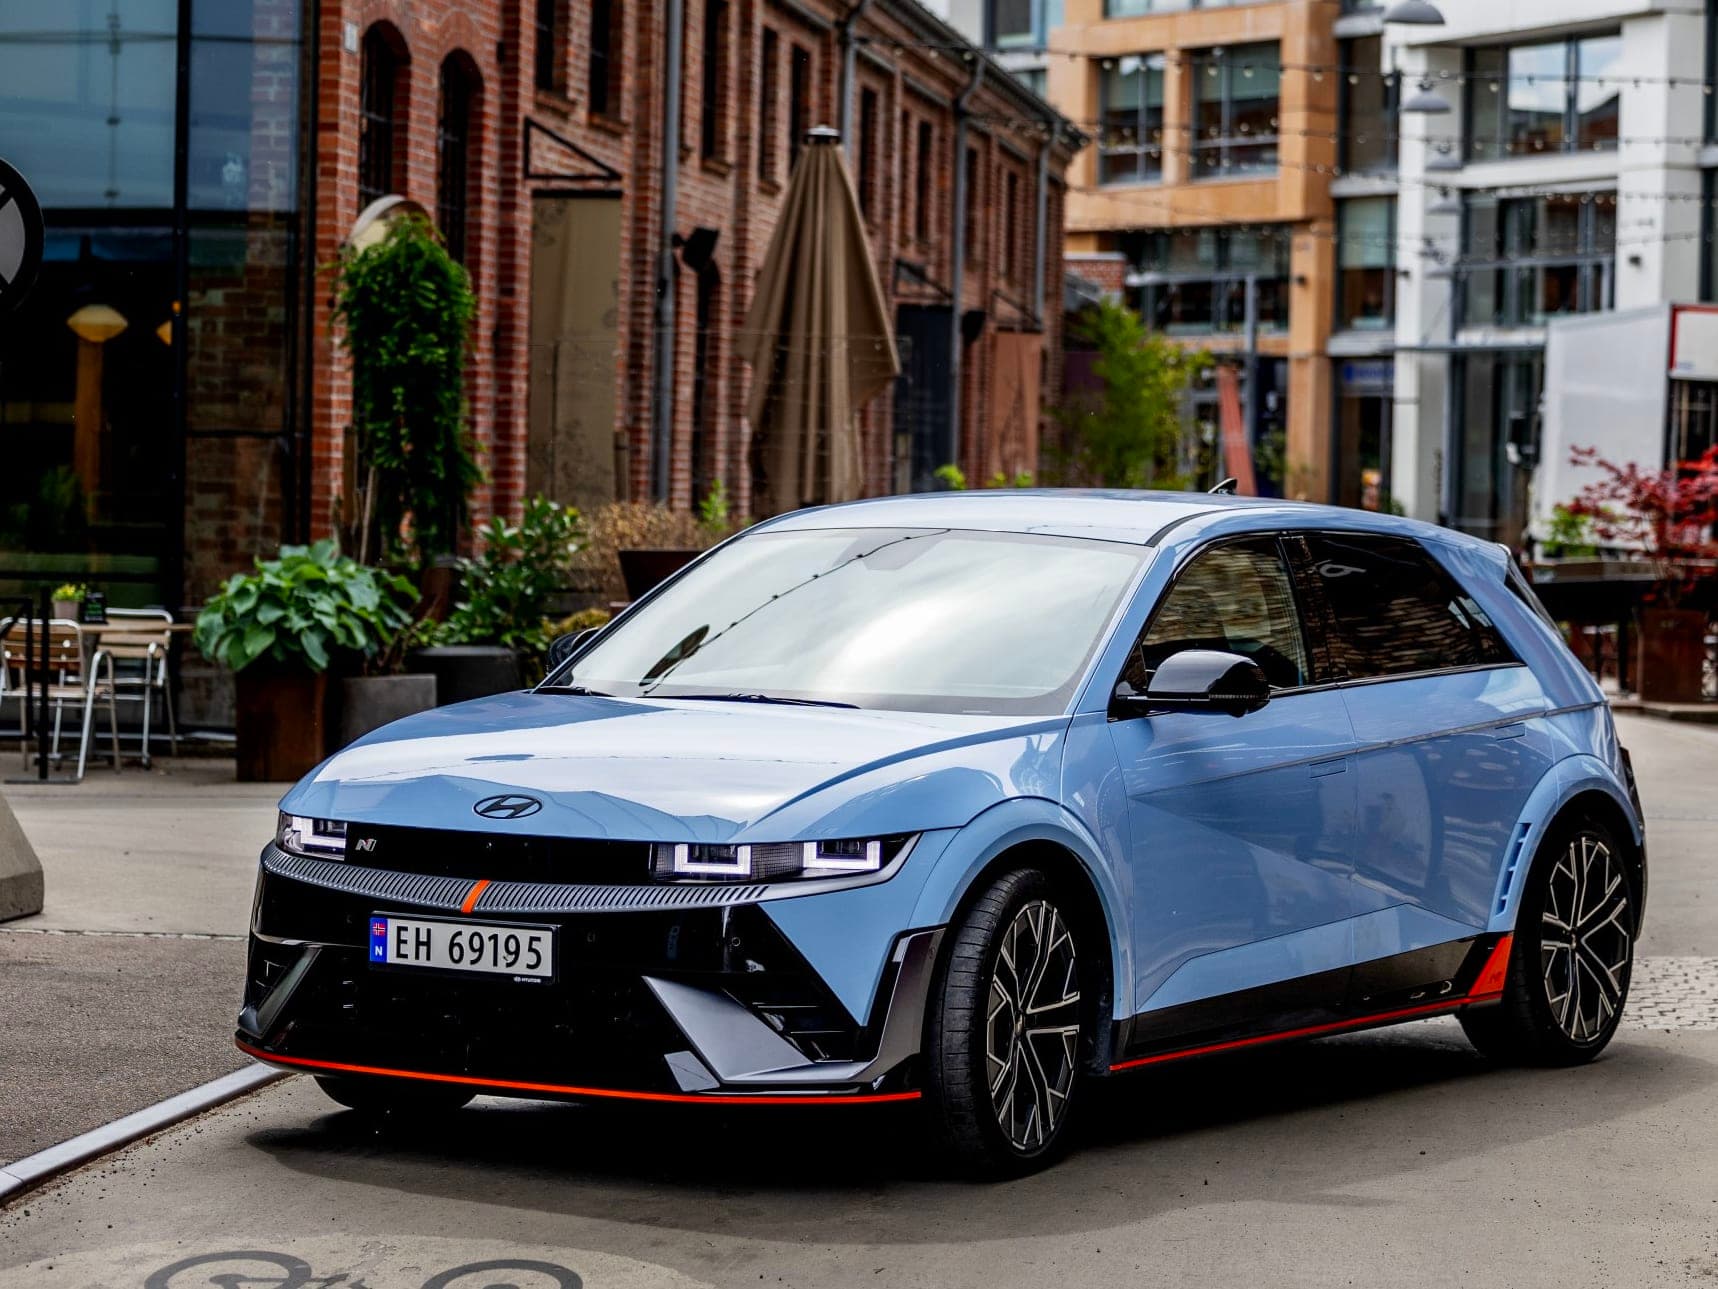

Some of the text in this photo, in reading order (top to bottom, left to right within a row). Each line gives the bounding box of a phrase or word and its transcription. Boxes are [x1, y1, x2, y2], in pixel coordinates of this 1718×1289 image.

[375, 946, 383, 956] N
[396, 925, 542, 970] EH 69195
